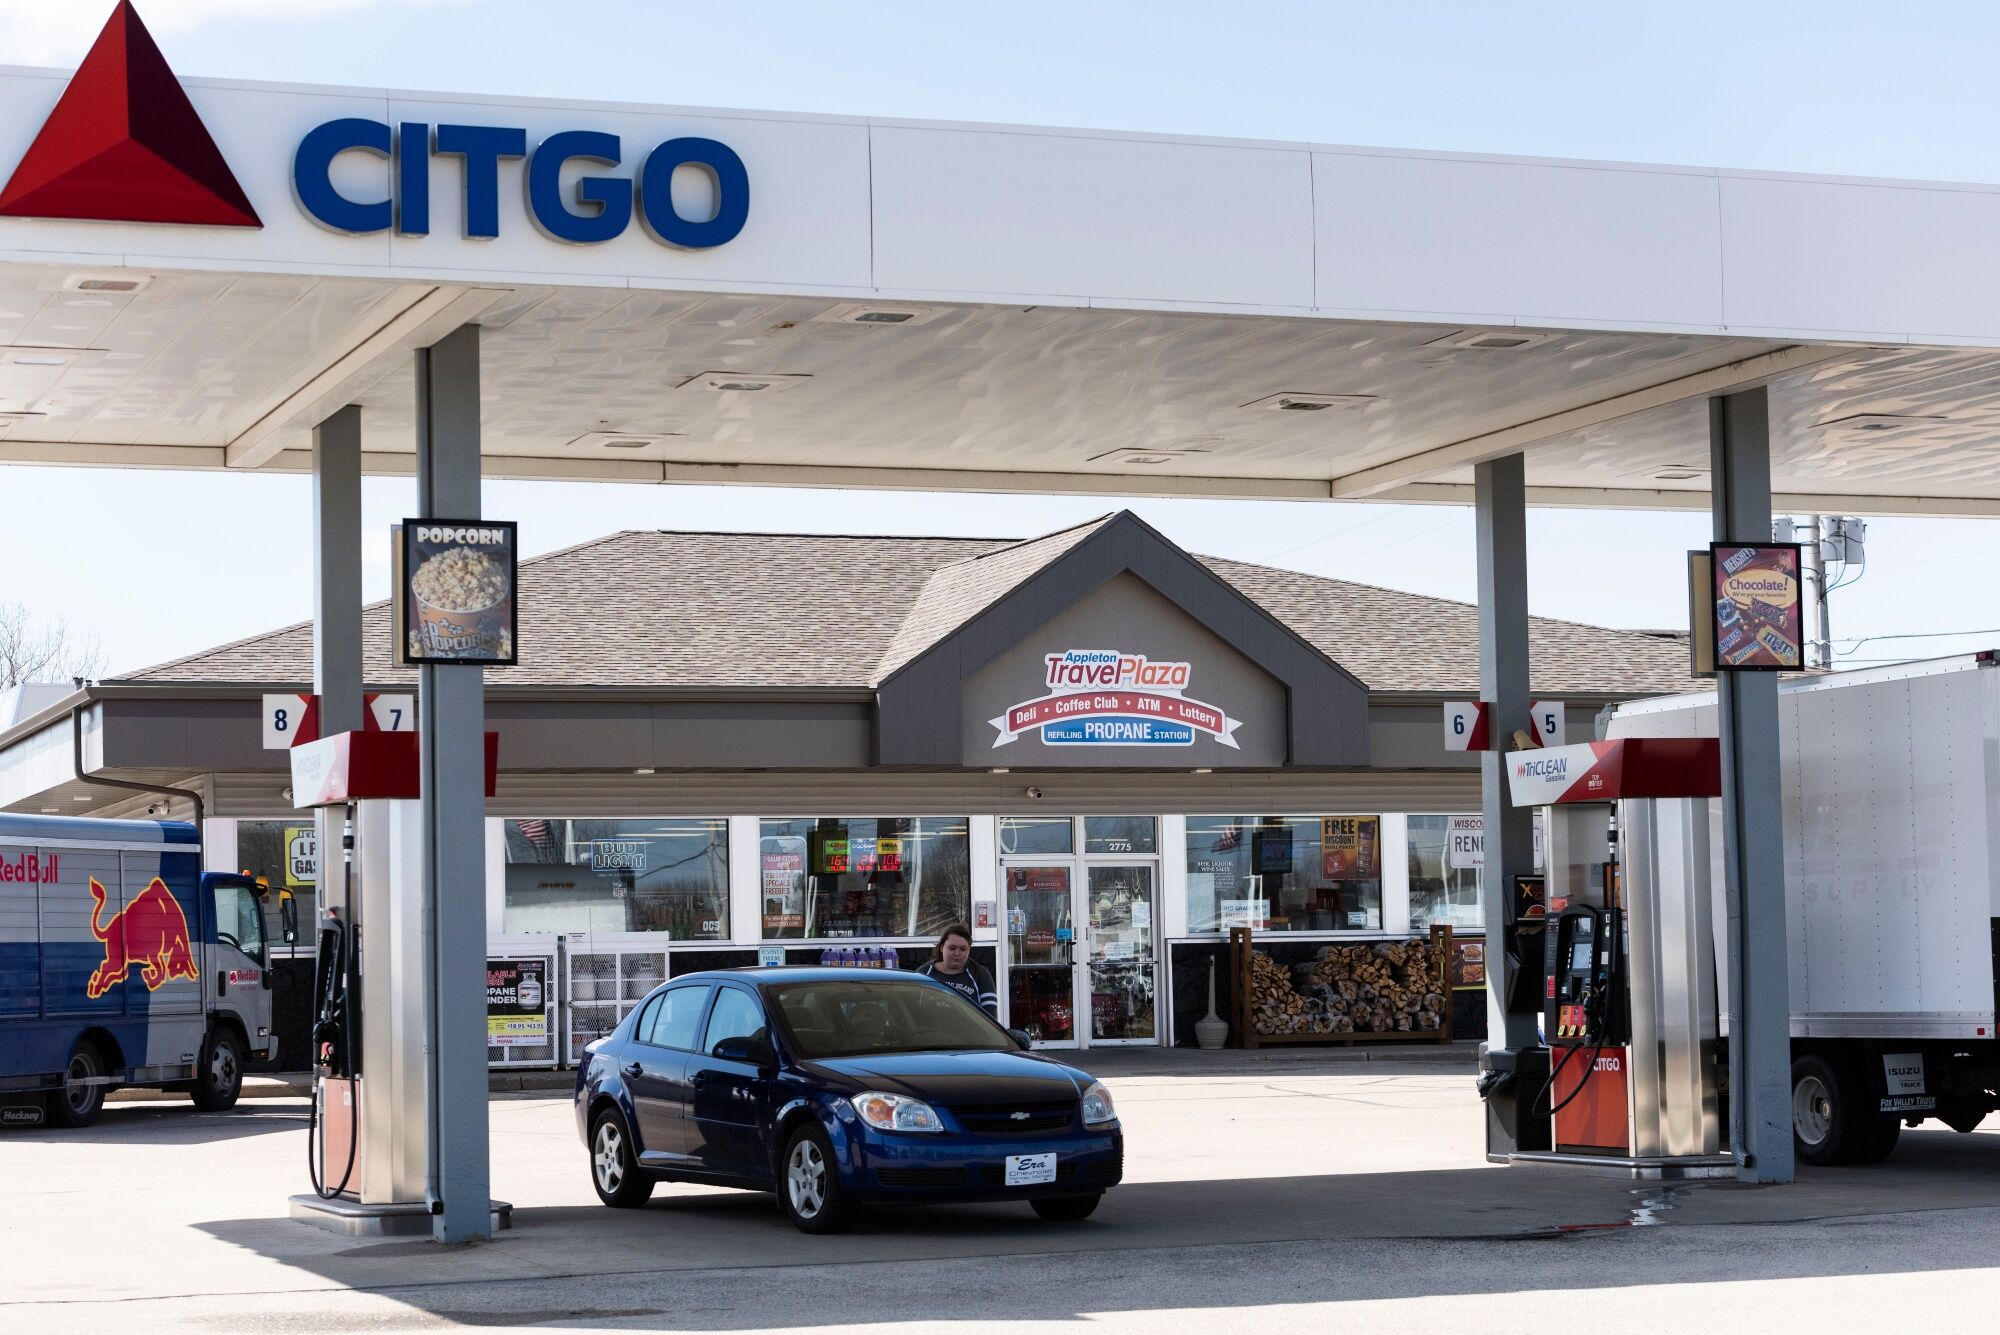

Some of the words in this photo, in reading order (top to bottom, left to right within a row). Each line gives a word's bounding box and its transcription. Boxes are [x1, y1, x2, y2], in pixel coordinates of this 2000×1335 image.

[292, 117, 750, 250] CITGO
[417, 526, 504, 545] POPCORN
[1729, 577, 1788, 591] Chocolate!
[1065, 652, 1117, 664] Appleton
[1016, 708, 1037, 724] Deli
[1055, 699, 1091, 714] Coffee
[1094, 696, 1119, 709] Club
[1137, 698, 1161, 711] ATM
[1180, 705, 1216, 728] Lottery
[274, 708, 288, 732] 8
[390, 709, 402, 731] 7
[1453, 714, 1465, 735] 6
[1545, 714, 1556, 734] 5
[1047, 731, 1083, 739] REFILLING
[1085, 722, 1152, 740] PROPANE
[1154, 731, 1189, 740] STATION
[1525, 757, 1567, 777] TriCLEAN
[1545, 774, 1566, 783] Gasoline
[1324, 819, 1355, 834] FREE
[1324, 835, 1355, 844] DISCOUNT
[600, 842, 637, 854] BUD
[1109, 843, 1132, 851] 2775
[295, 860, 316, 874] GA
[594, 854, 643, 868] LIGHT
[27, 854, 58, 884] Bull
[702, 921, 720, 931] OCS
[237, 970, 248, 979] Red
[248, 970, 258, 979] Bull
[1887, 1067, 1920, 1076] ISUZU
[1880, 1098, 1892, 1107] FOX
[1893, 1097, 1915, 1106] VALLEY
[1916, 1096, 1936, 1105] TRUCK
[3, 1109, 39, 1122] Hackney
[1018, 1158, 1046, 1171] Era
[1009, 1169, 1054, 1177] Chevrolet
